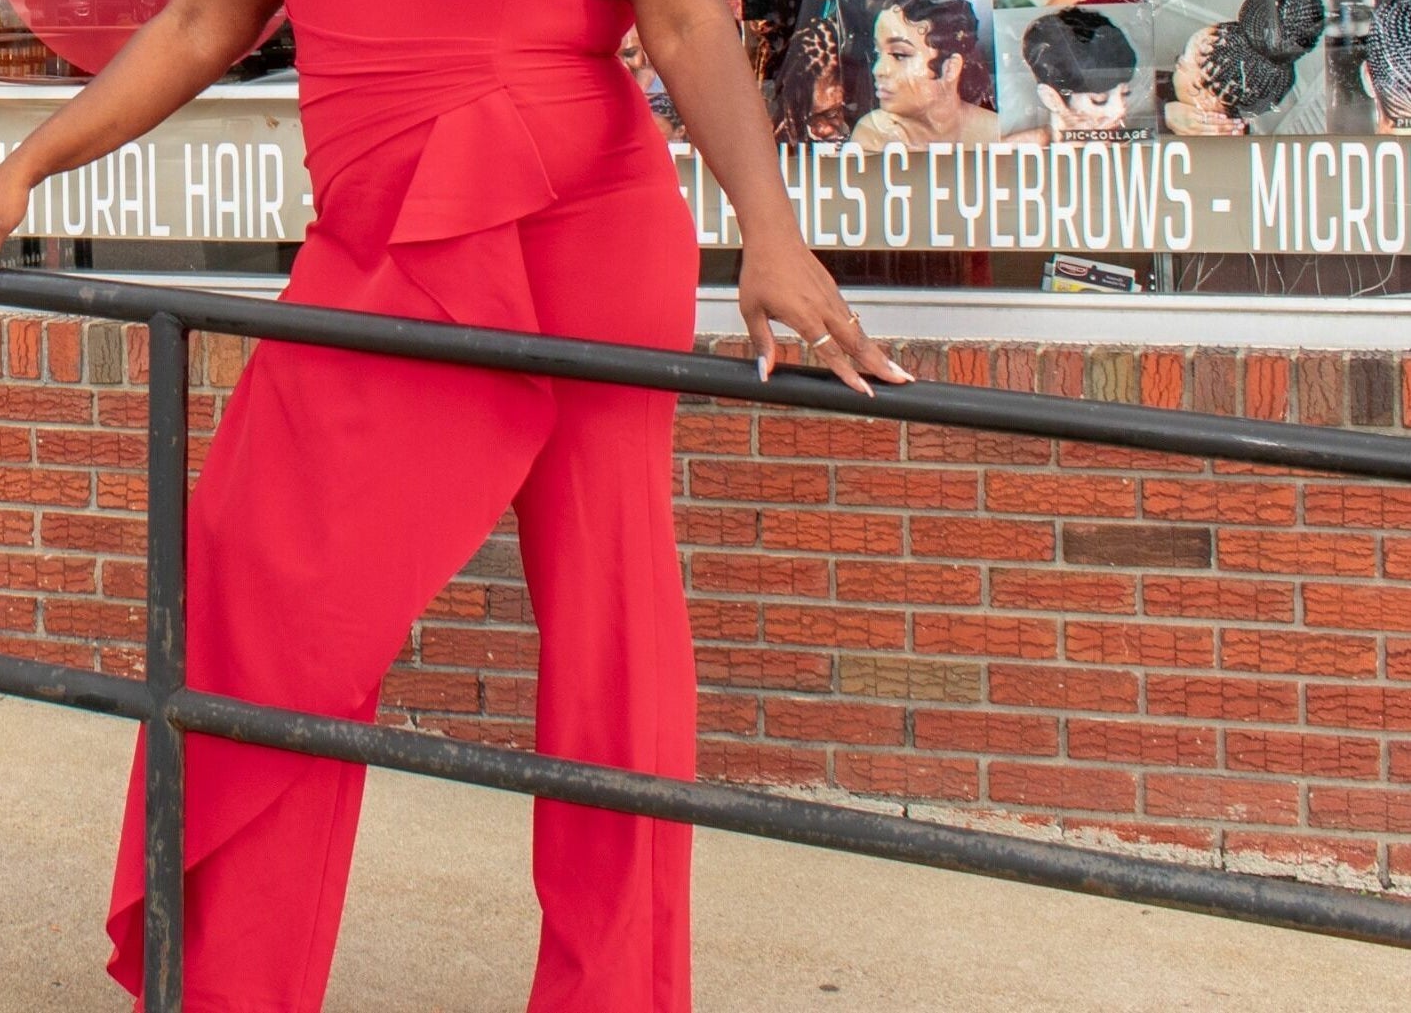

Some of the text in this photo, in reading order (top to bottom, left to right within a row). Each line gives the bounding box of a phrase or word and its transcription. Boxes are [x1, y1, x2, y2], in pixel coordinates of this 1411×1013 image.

[184, 142, 286, 239] HAIR
[883, 142, 911, 248] &
[928, 141, 1193, 250] EYEBROWS
[1250, 141, 1406, 253] MICRO
